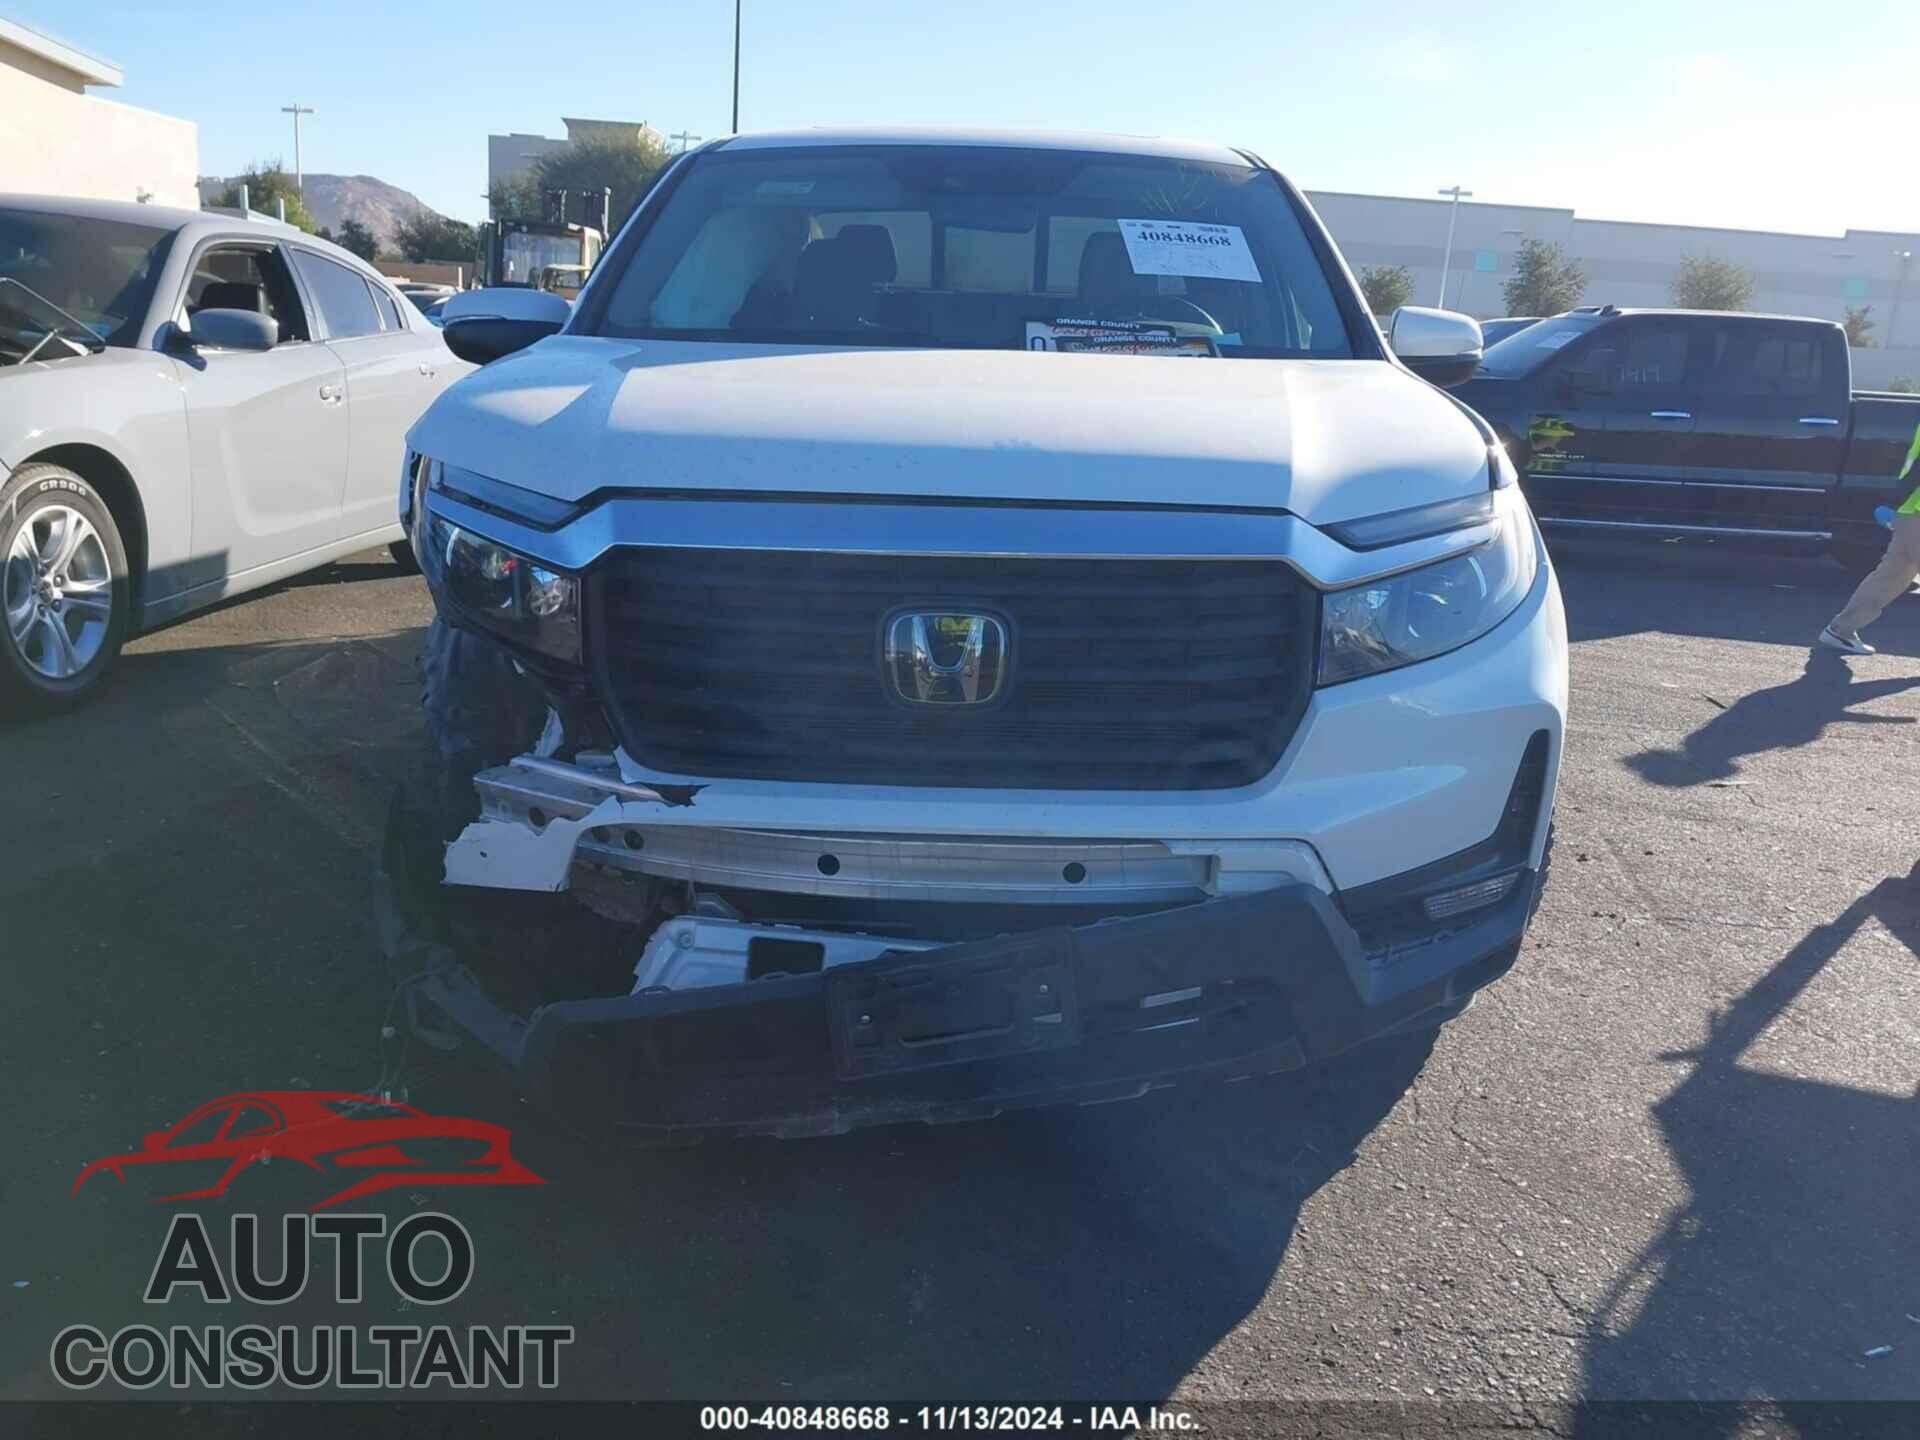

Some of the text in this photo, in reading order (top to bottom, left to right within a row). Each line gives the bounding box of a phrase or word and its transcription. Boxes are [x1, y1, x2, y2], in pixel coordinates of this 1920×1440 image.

[1137, 231, 1232, 246] 40848668
[1056, 318, 1140, 329] ORANGE COUNTY
[1094, 335, 1177, 343] ORANGE COUNTY
